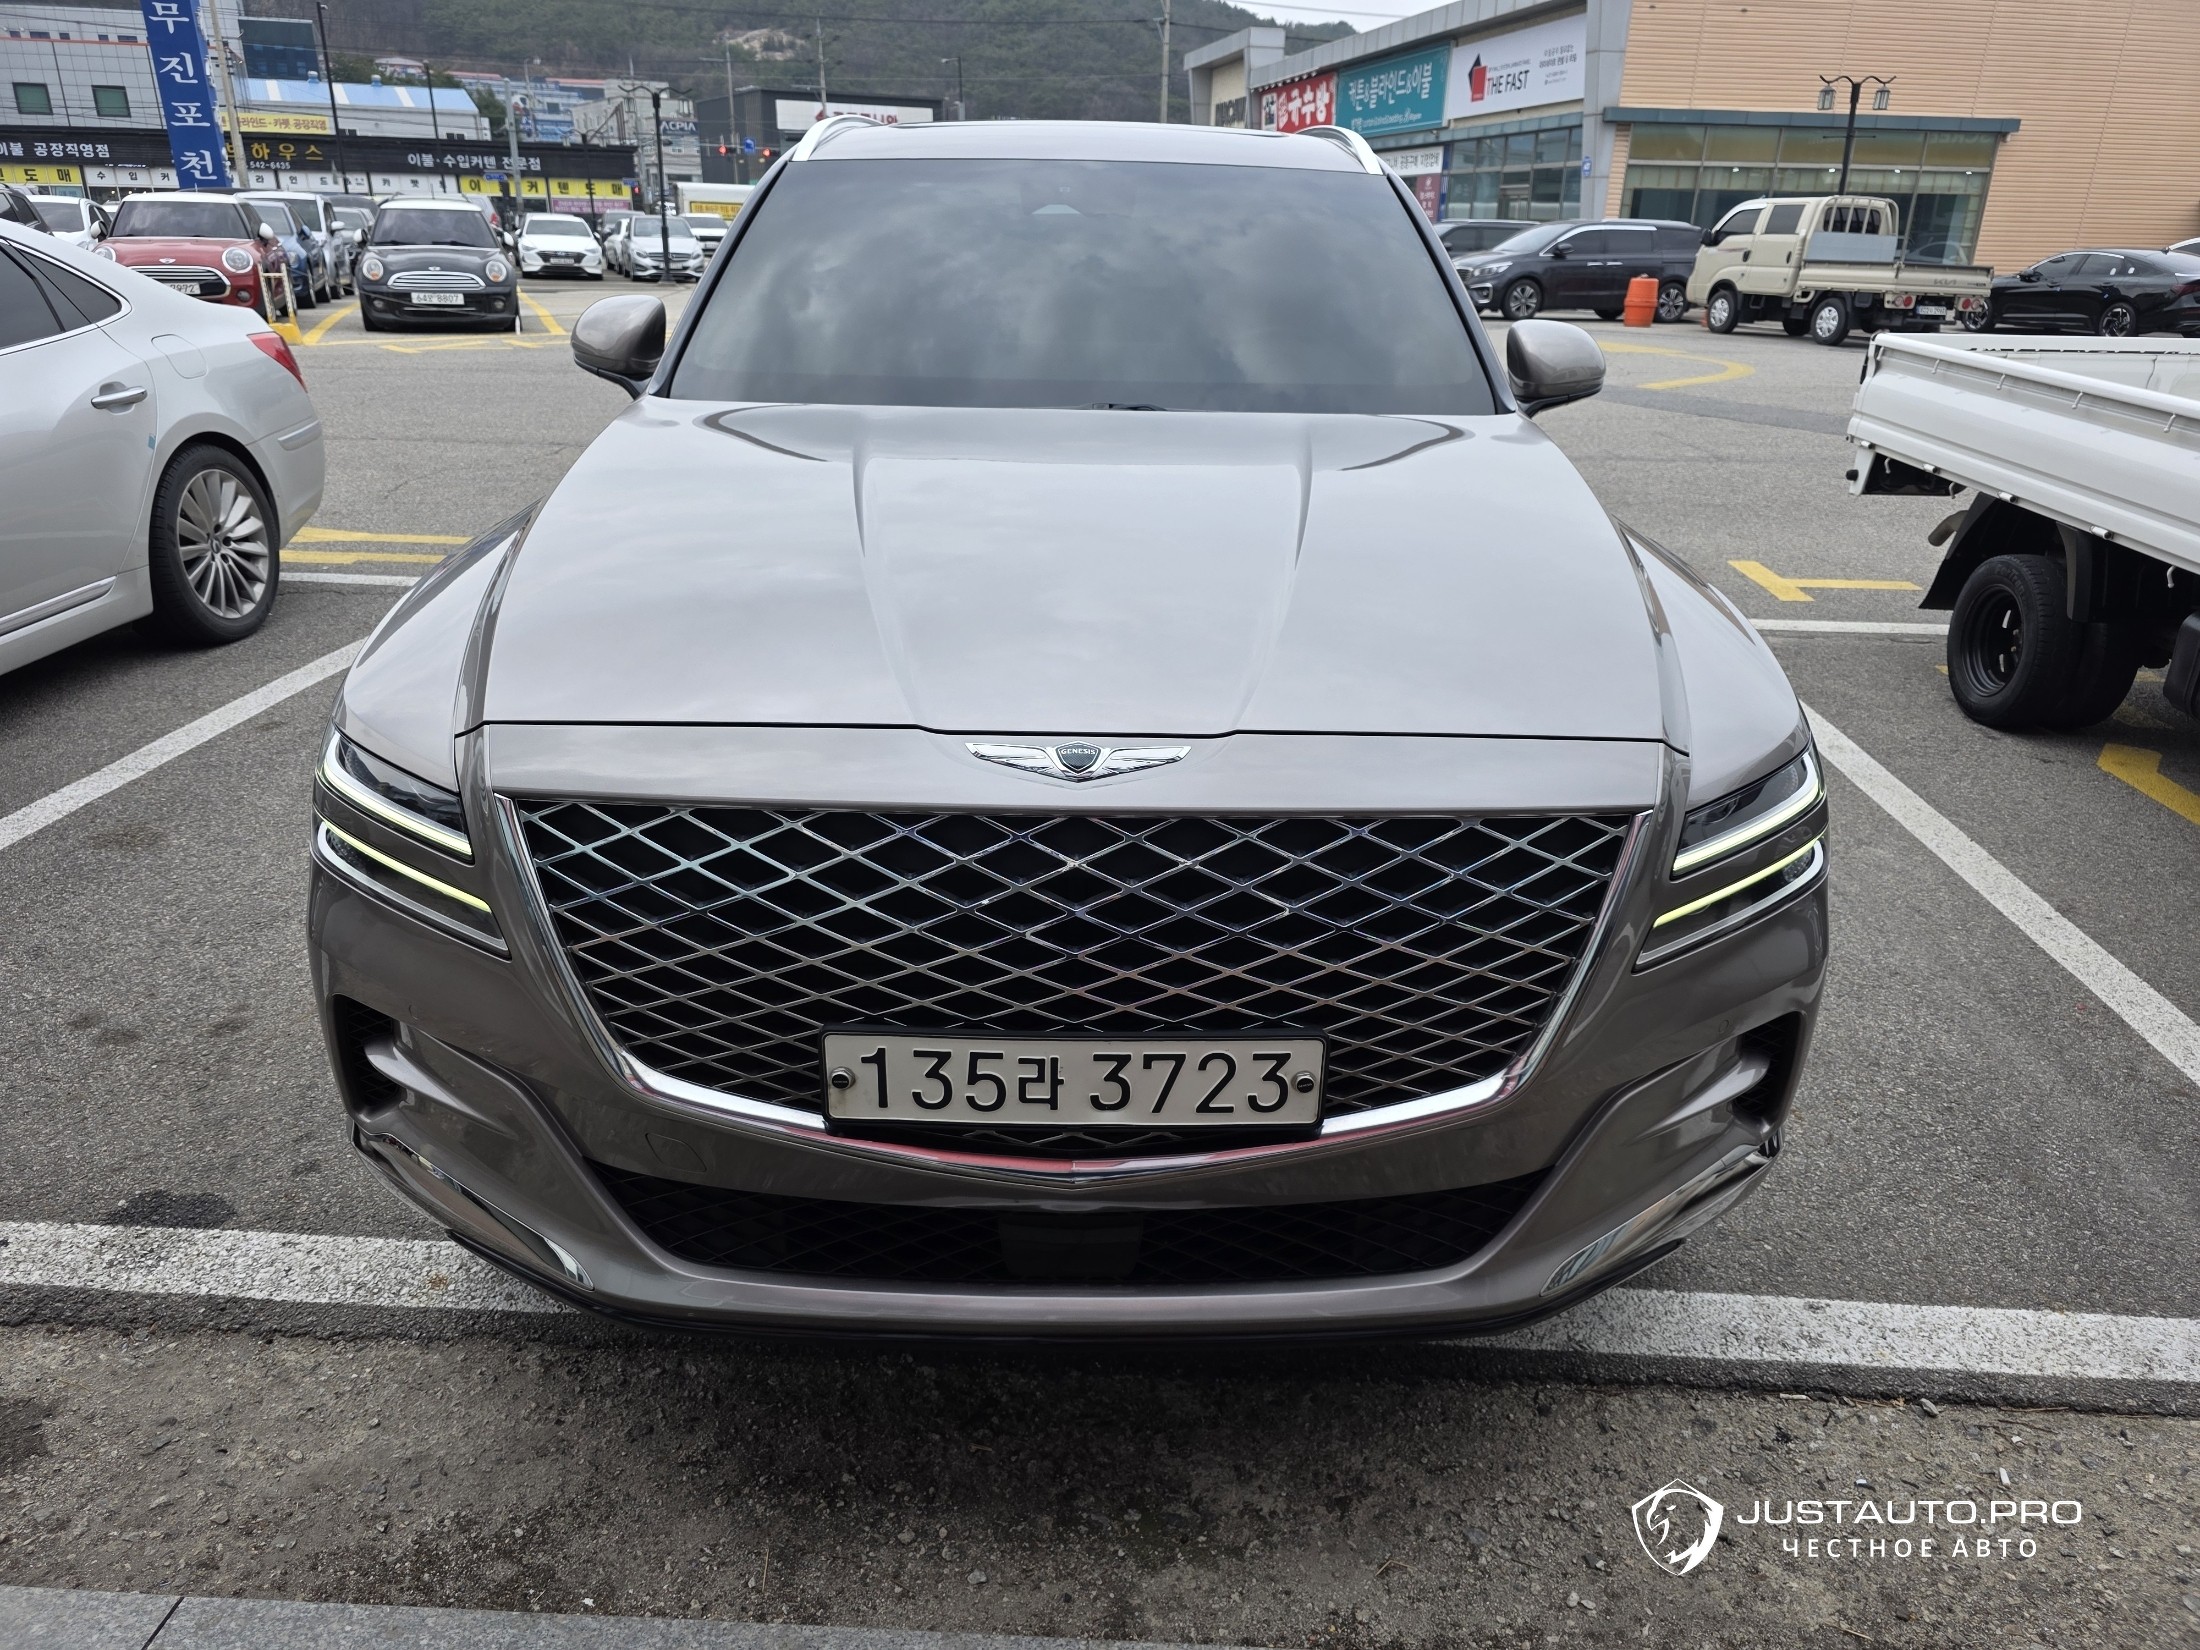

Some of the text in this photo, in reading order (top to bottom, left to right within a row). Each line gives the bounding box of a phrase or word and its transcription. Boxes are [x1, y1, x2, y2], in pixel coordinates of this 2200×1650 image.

[1487, 69, 1531, 96] THE FAST
[660, 121, 697, 133] ACPIA
[34, 142, 111, 158] 공장직영점
[1061, 747, 1096, 756] GENESIS
[860, 1046, 1292, 1114] 135라 3723
